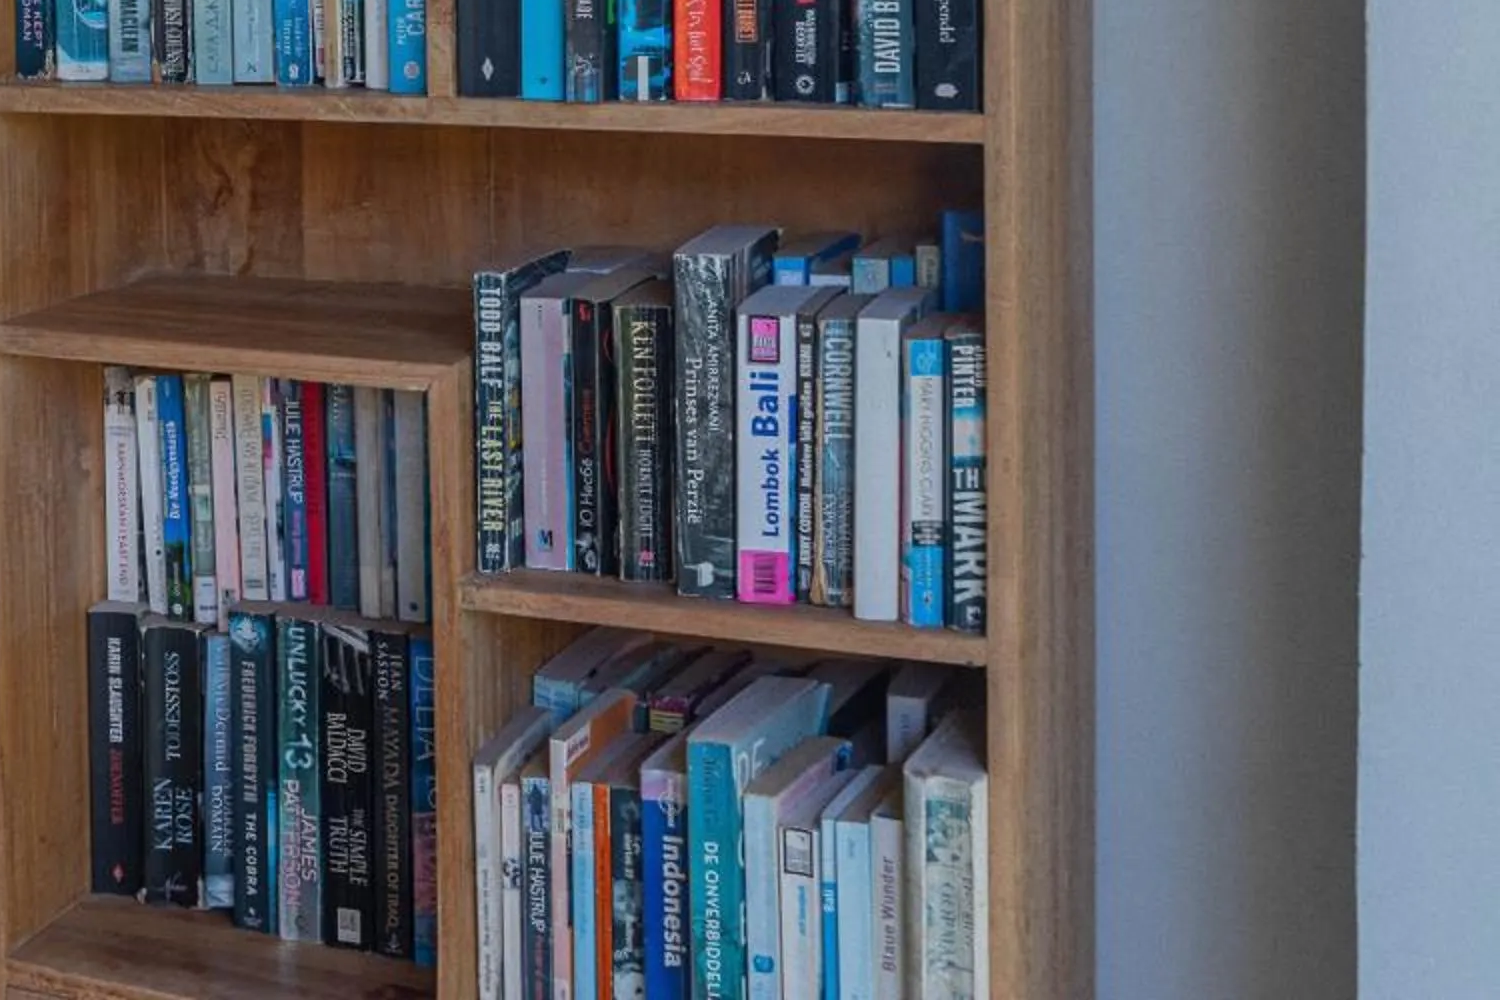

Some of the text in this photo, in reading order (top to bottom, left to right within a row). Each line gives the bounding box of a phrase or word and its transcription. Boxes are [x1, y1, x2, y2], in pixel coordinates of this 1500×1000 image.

[33, 12, 43, 50] KEPT
[874, 19, 900, 73] DAVID
[631, 320, 657, 359] KEN
[707, 300, 722, 432] ANITA AMIRREZVANI
[952, 345, 975, 409] PINTER
[480, 288, 503, 531] TODD BALF THE LAST RIVER
[633, 366, 657, 443] FOLLETT
[823, 337, 853, 444] CORNWELL
[287, 438, 304, 505] HASTRUP
[685, 357, 705, 524] Prinses van Perzië
[749, 371, 779, 538] Lombok Bali
[920, 415, 933, 474] HIGGINS
[579, 508, 593, 527] Ю
[799, 493, 812, 533] COTTON
[953, 491, 987, 603] MARK
[107, 637, 124, 743] KARIN SLAUGHTER
[164, 651, 182, 761] TODESSTOSS
[285, 626, 313, 769] UNLUCKY 13
[377, 640, 389, 700] SASSON
[389, 654, 404, 691] JEAN
[214, 680, 232, 772] McDermid
[327, 711, 347, 785] BALDACCI
[346, 727, 367, 773] DAVID
[153, 776, 173, 852] KAREN
[175, 787, 194, 844] ROSE
[241, 660, 258, 896] FREDERICK FORSYTH THE COBRA
[211, 784, 224, 853] DOMAIN
[283, 779, 301, 907] PATTERSON
[300, 807, 317, 882] JAMES
[329, 815, 348, 874] TRUTH
[382, 705, 400, 932] MAYADA DAUGHTER OF IRAQ
[348, 828, 368, 887] SIMPLE
[530, 867, 547, 933] HASTRUP
[662, 834, 688, 968] Indonesia
[704, 841, 722, 1000] DE ONVERBIDDELI
[880, 855, 898, 972] Blaue Wunder
